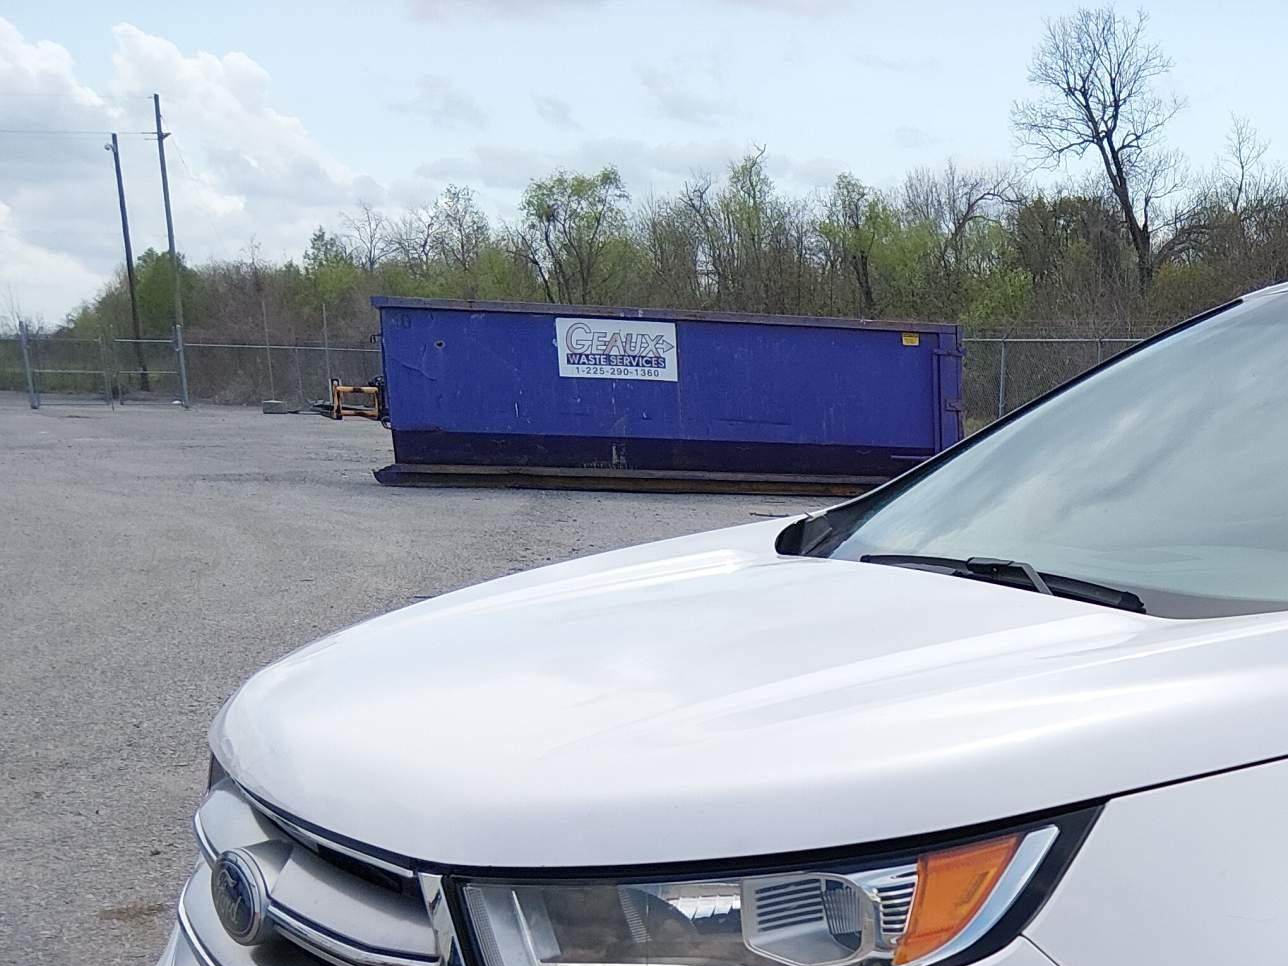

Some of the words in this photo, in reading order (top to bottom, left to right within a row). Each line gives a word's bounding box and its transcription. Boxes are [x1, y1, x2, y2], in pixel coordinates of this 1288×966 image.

[565, 322, 664, 357] GEAUX
[567, 354, 608, 365] WASTE
[609, 354, 666, 368] SERVICES
[575, 366, 660, 377] 1-225-290-1360
